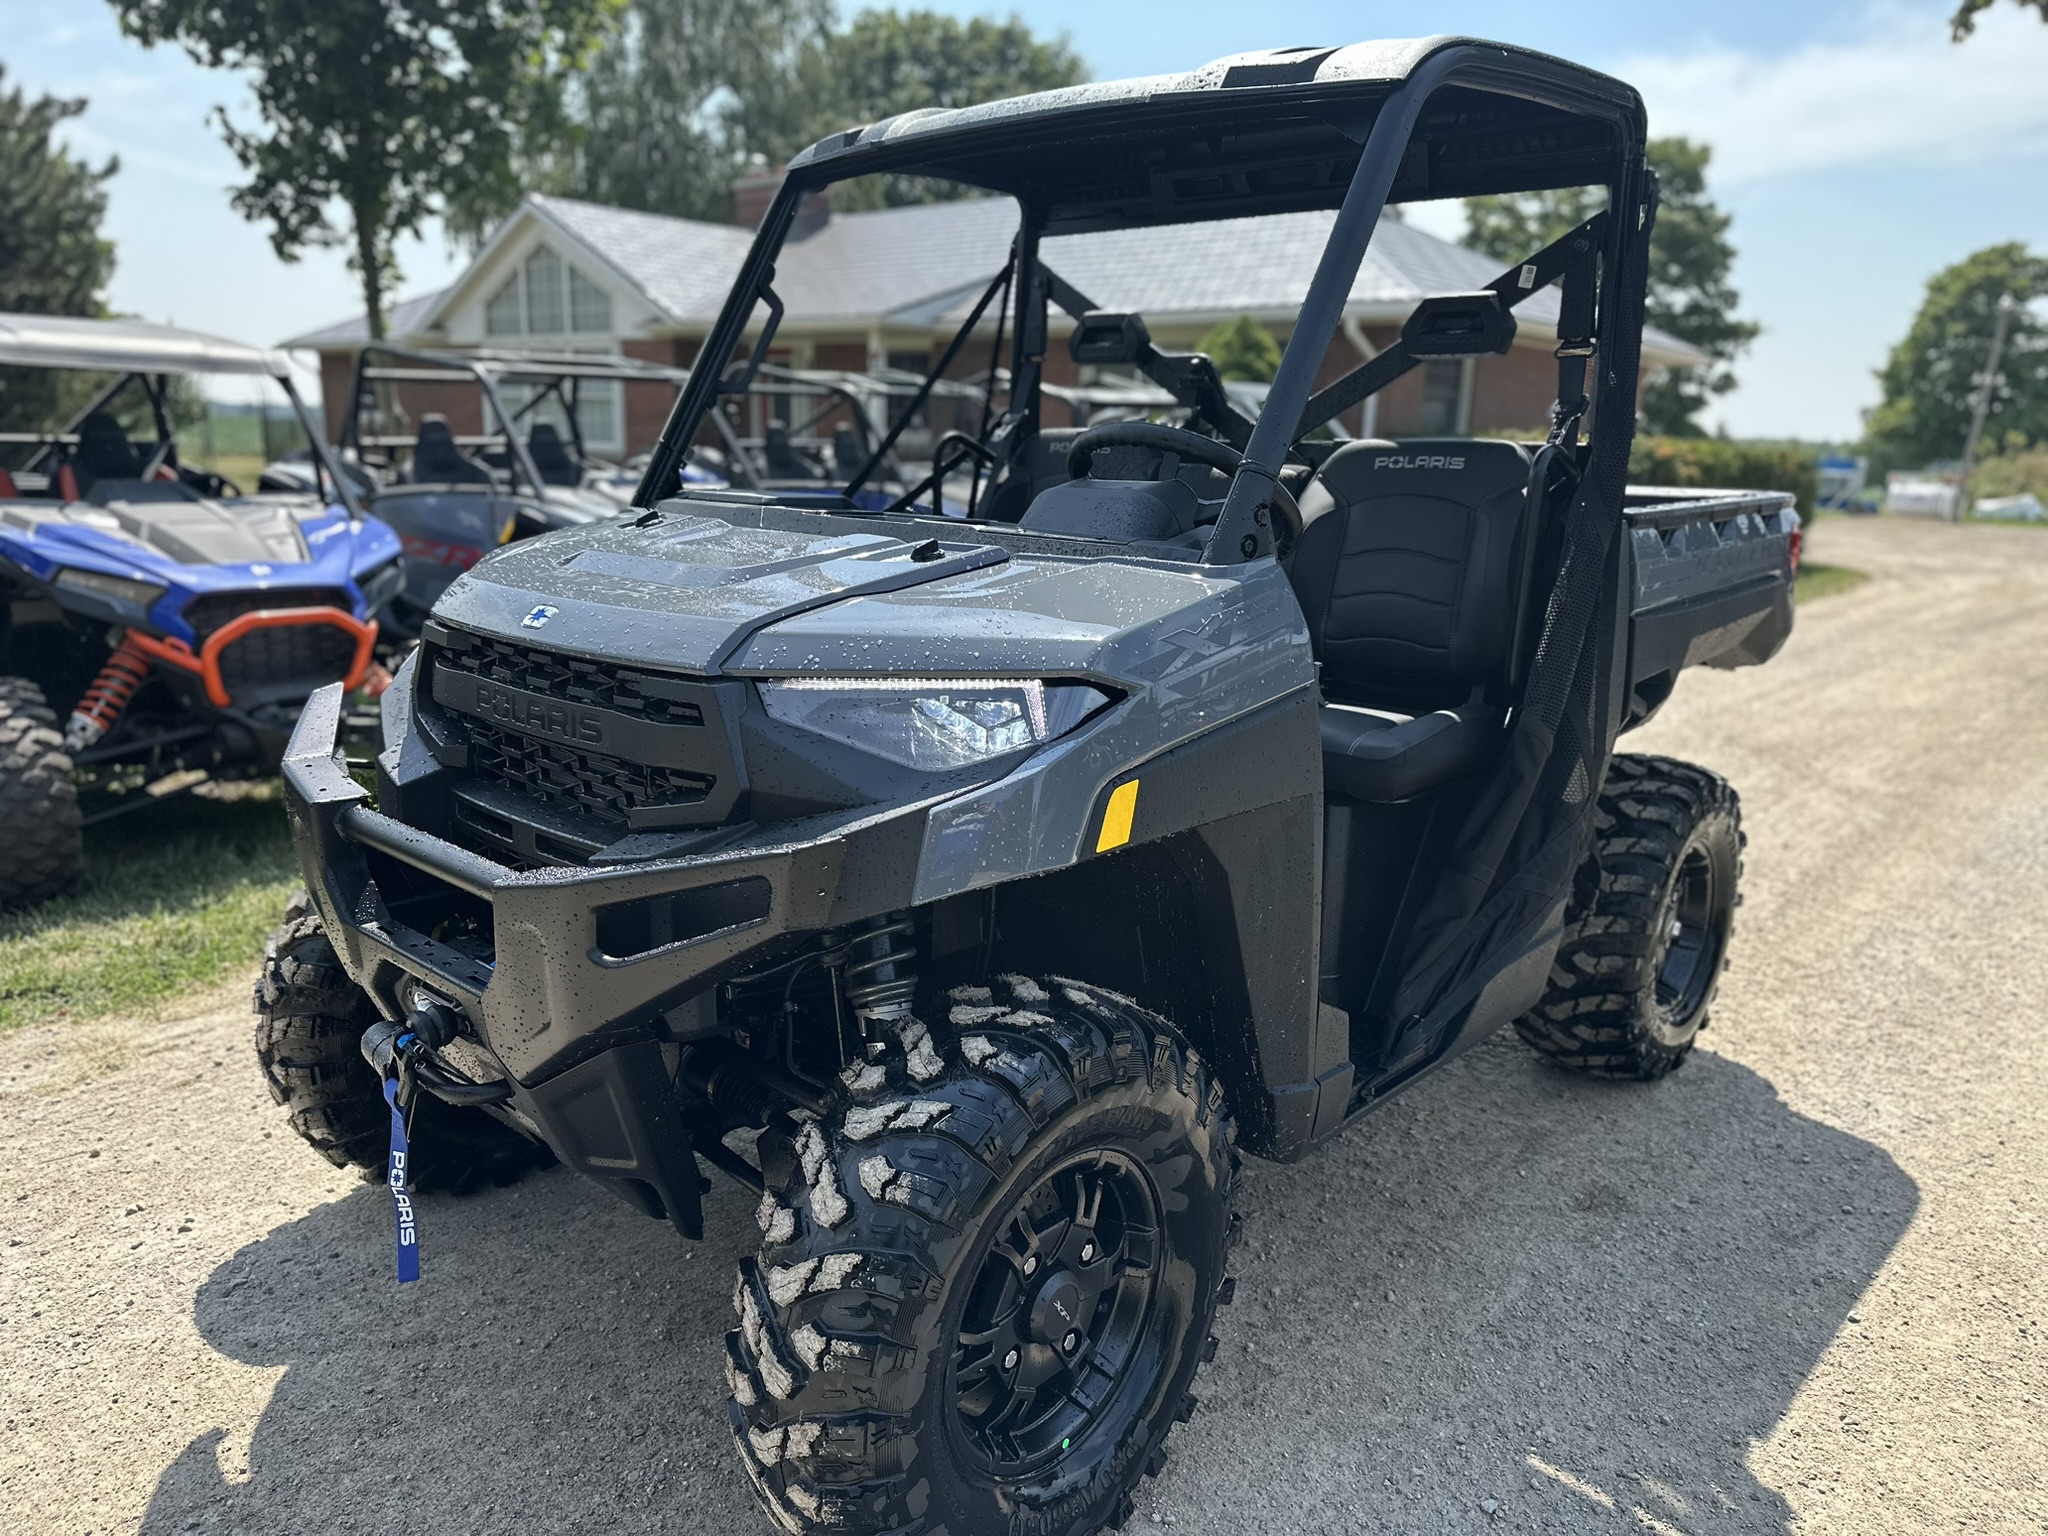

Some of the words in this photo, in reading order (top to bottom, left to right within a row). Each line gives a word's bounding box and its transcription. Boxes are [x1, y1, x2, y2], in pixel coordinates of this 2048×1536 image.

[1374, 456, 1465, 470] POLARIS
[477, 684, 603, 745] POLARIS
[390, 1150, 416, 1246] POLARIS
[1052, 1300, 1071, 1321] XP
